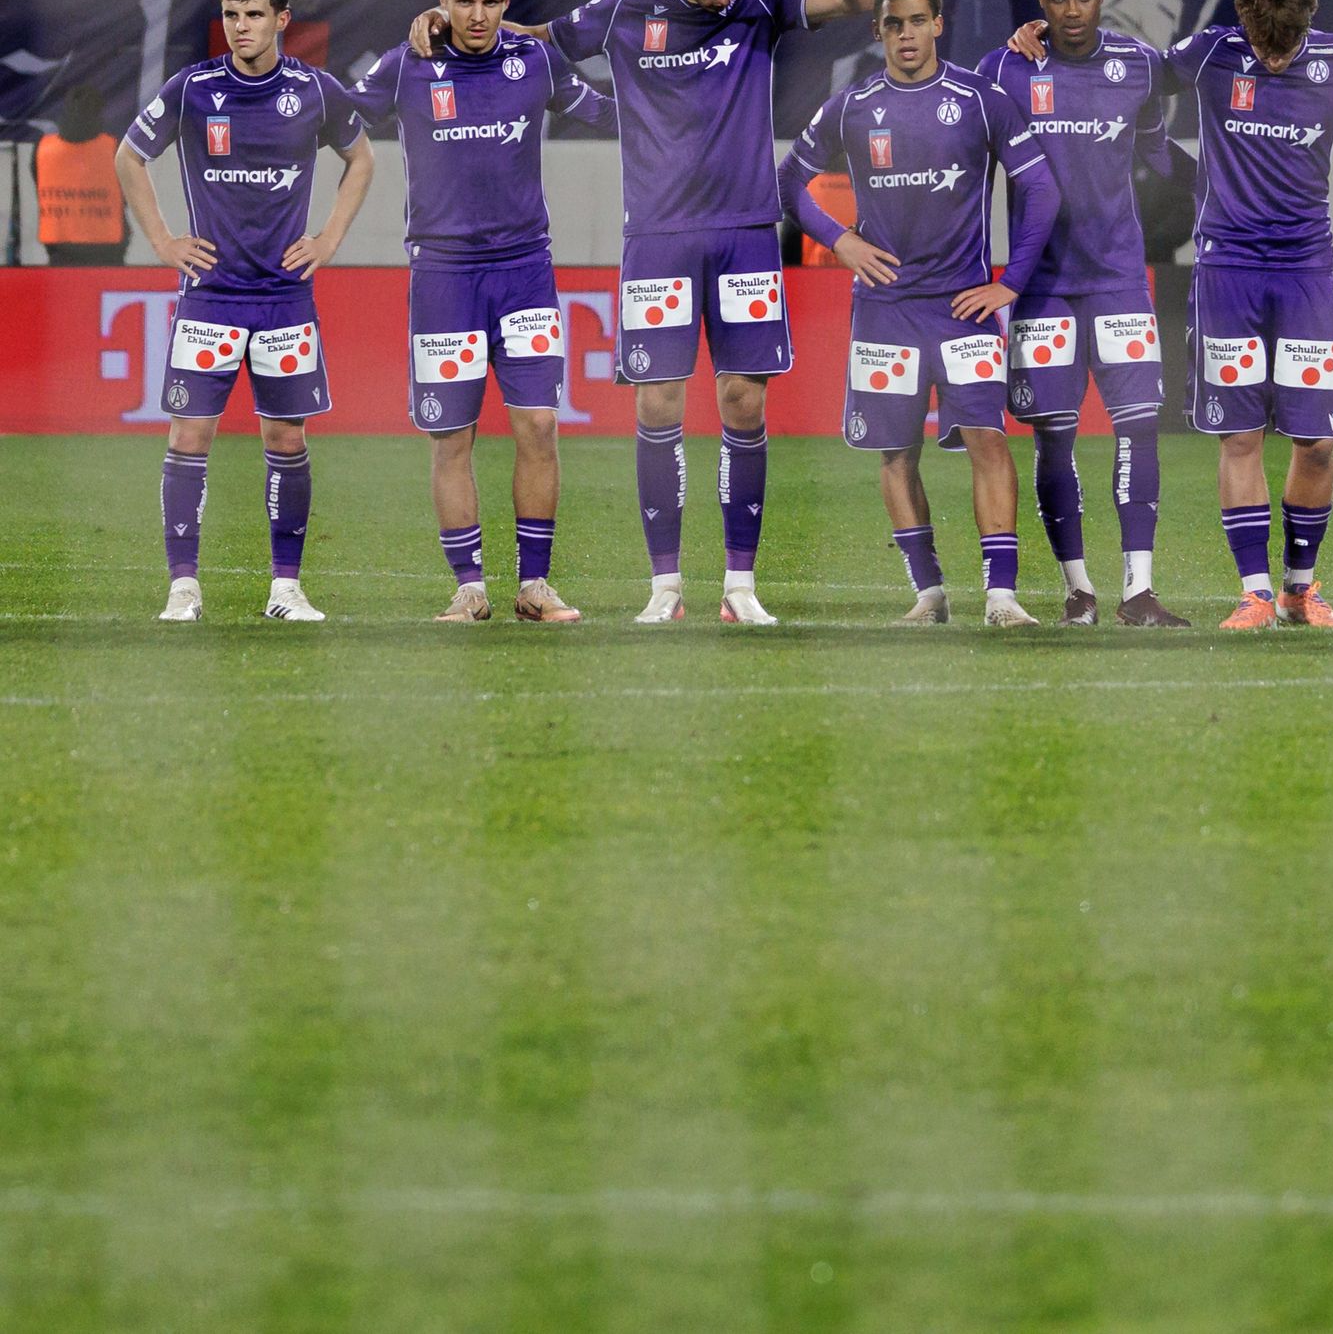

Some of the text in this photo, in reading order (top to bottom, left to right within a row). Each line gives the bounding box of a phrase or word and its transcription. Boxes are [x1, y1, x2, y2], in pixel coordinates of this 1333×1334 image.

[639, 48, 711, 68] aramark
[433, 122, 507, 142] aramark
[1029, 119, 1103, 134] aramark
[1225, 119, 1300, 140] aramark
[204, 167, 277, 183] aramark
[869, 169, 938, 188] aramark
[627, 284, 668, 295] Schuller
[728, 278, 770, 288] Schuller
[509, 313, 552, 327] Schuller
[1104, 318, 1147, 329] Schuller
[182, 325, 224, 339] Schuller
[1014, 322, 1056, 334] Schuller
[259, 333, 301, 344] Schuller
[420, 339, 463, 348] Schuller
[856, 346, 896, 359] Schuller
[951, 340, 993, 353] Schuller
[1284, 344, 1327, 355] Schuller
